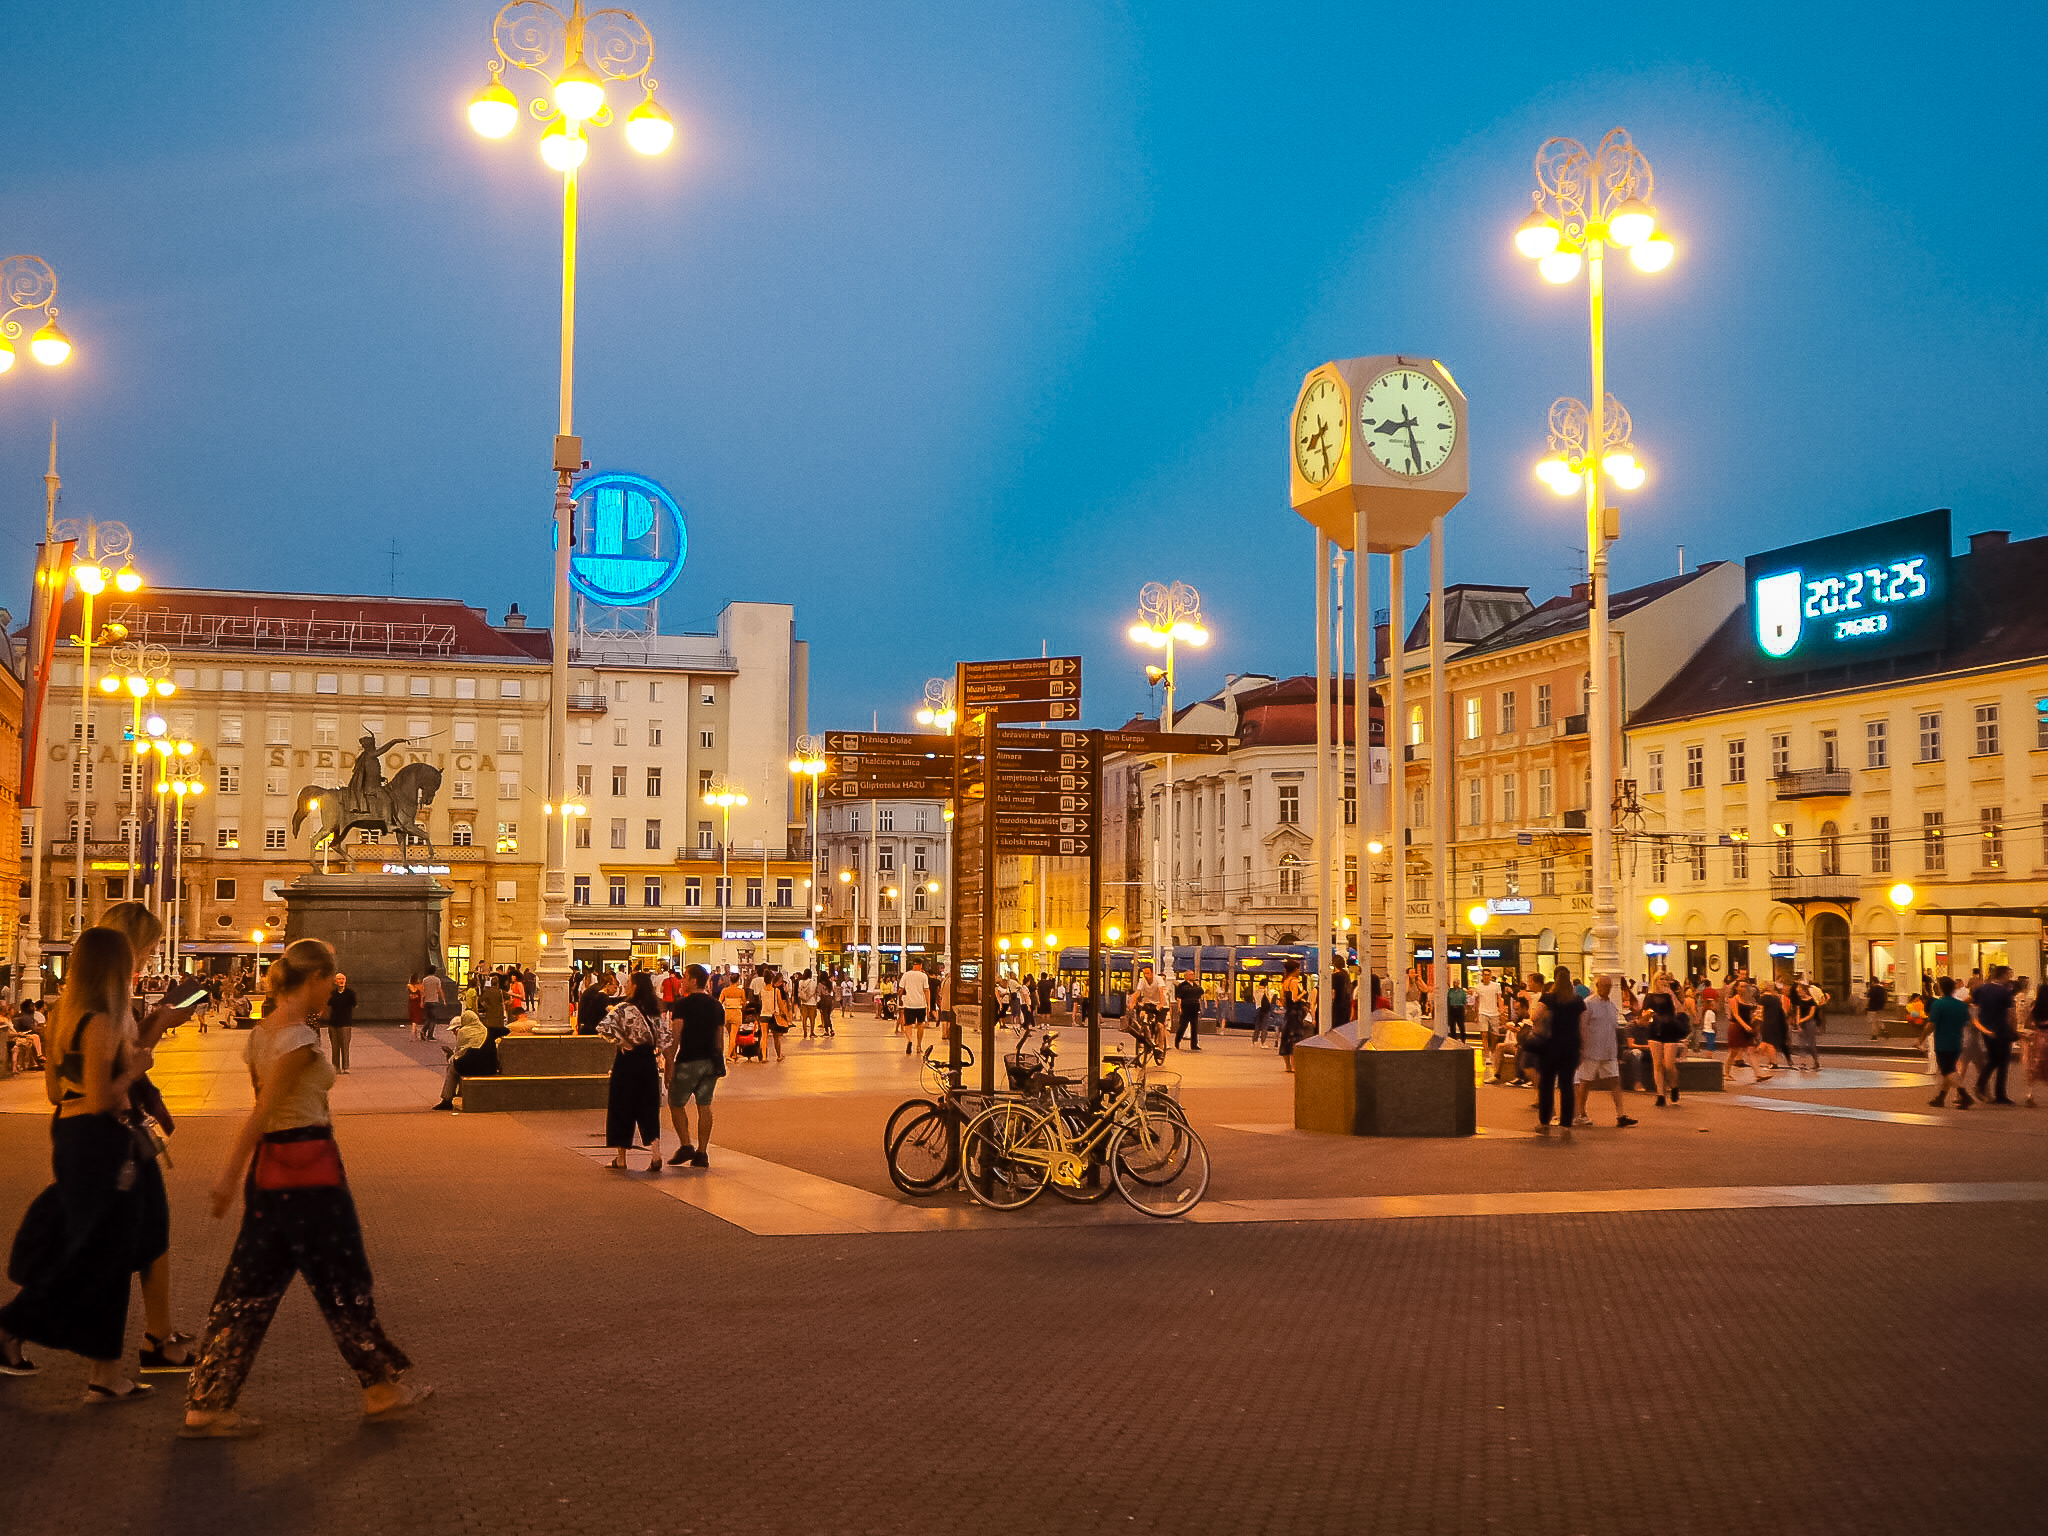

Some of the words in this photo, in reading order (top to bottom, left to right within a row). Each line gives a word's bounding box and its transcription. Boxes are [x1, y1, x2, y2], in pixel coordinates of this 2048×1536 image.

[1804, 558, 1926, 618] 20:27:25
[269, 746, 497, 772] ŠTEDONICA
[902, 759, 921, 767] ulica
[902, 781, 926, 789] HAZU
